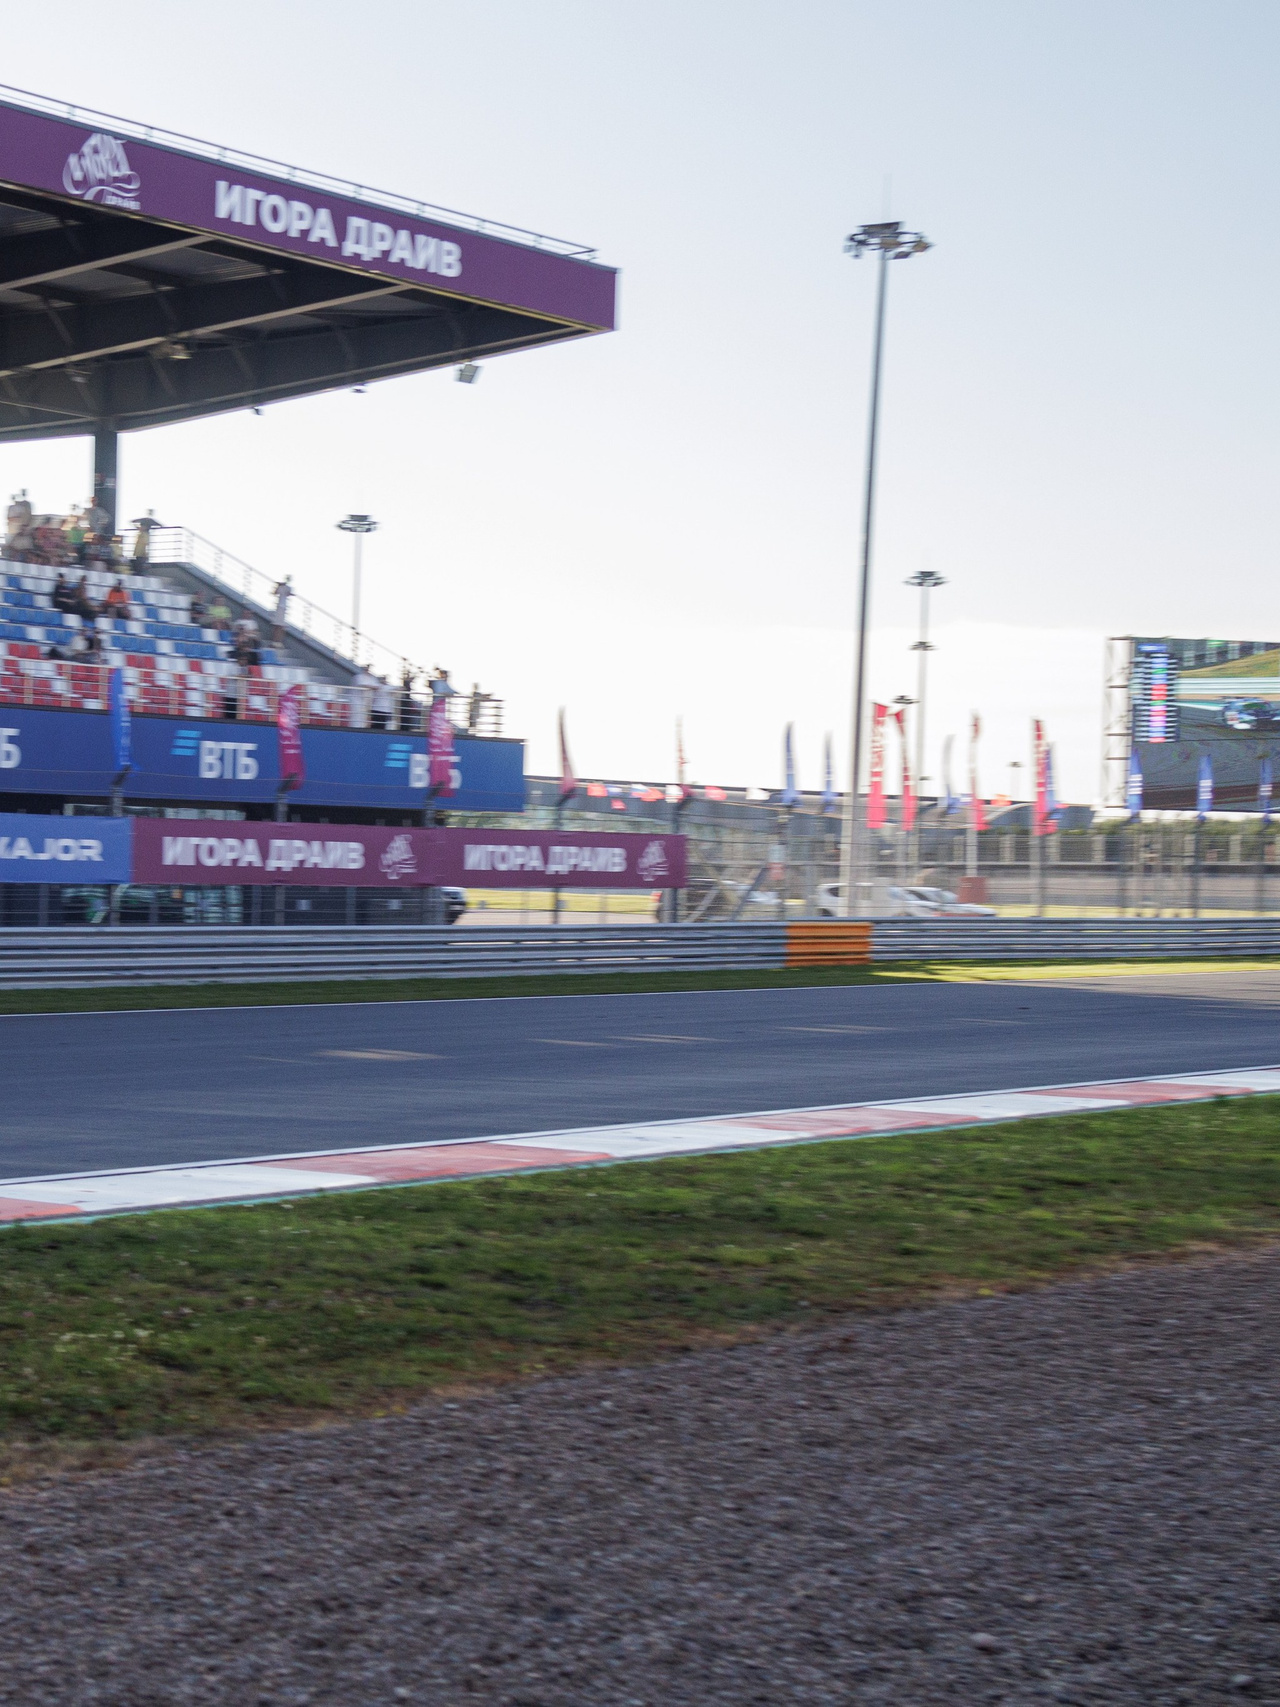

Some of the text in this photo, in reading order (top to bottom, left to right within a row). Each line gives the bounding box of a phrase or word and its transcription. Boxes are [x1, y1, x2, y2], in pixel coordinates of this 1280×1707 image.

[215, 180, 338, 247] ИГОРА
[199, 741, 259, 779] ВТБ
[410, 754, 462, 789] ВБ
[162, 836, 263, 866] ИГОРА
[464, 844, 545, 871] ИГОРА
